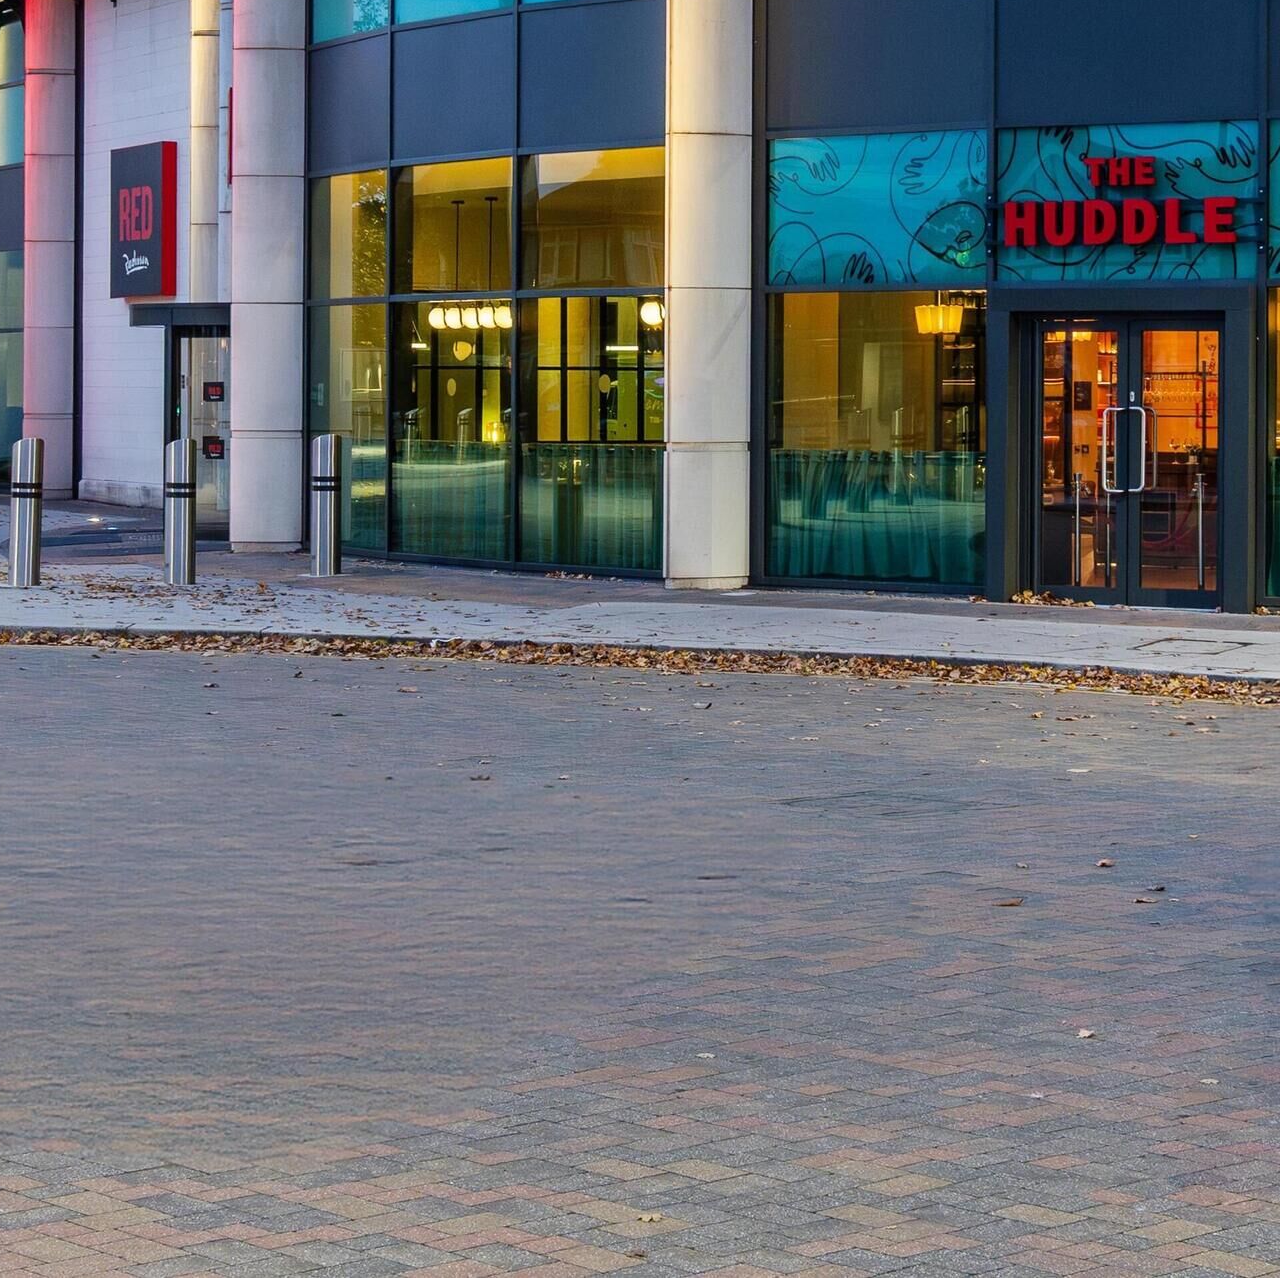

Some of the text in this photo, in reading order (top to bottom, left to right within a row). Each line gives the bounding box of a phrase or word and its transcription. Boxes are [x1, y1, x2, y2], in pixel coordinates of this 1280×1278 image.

[1083, 156, 1156, 187] THE
[119, 185, 153, 242] RED
[1003, 196, 1238, 247] HUDDLE
